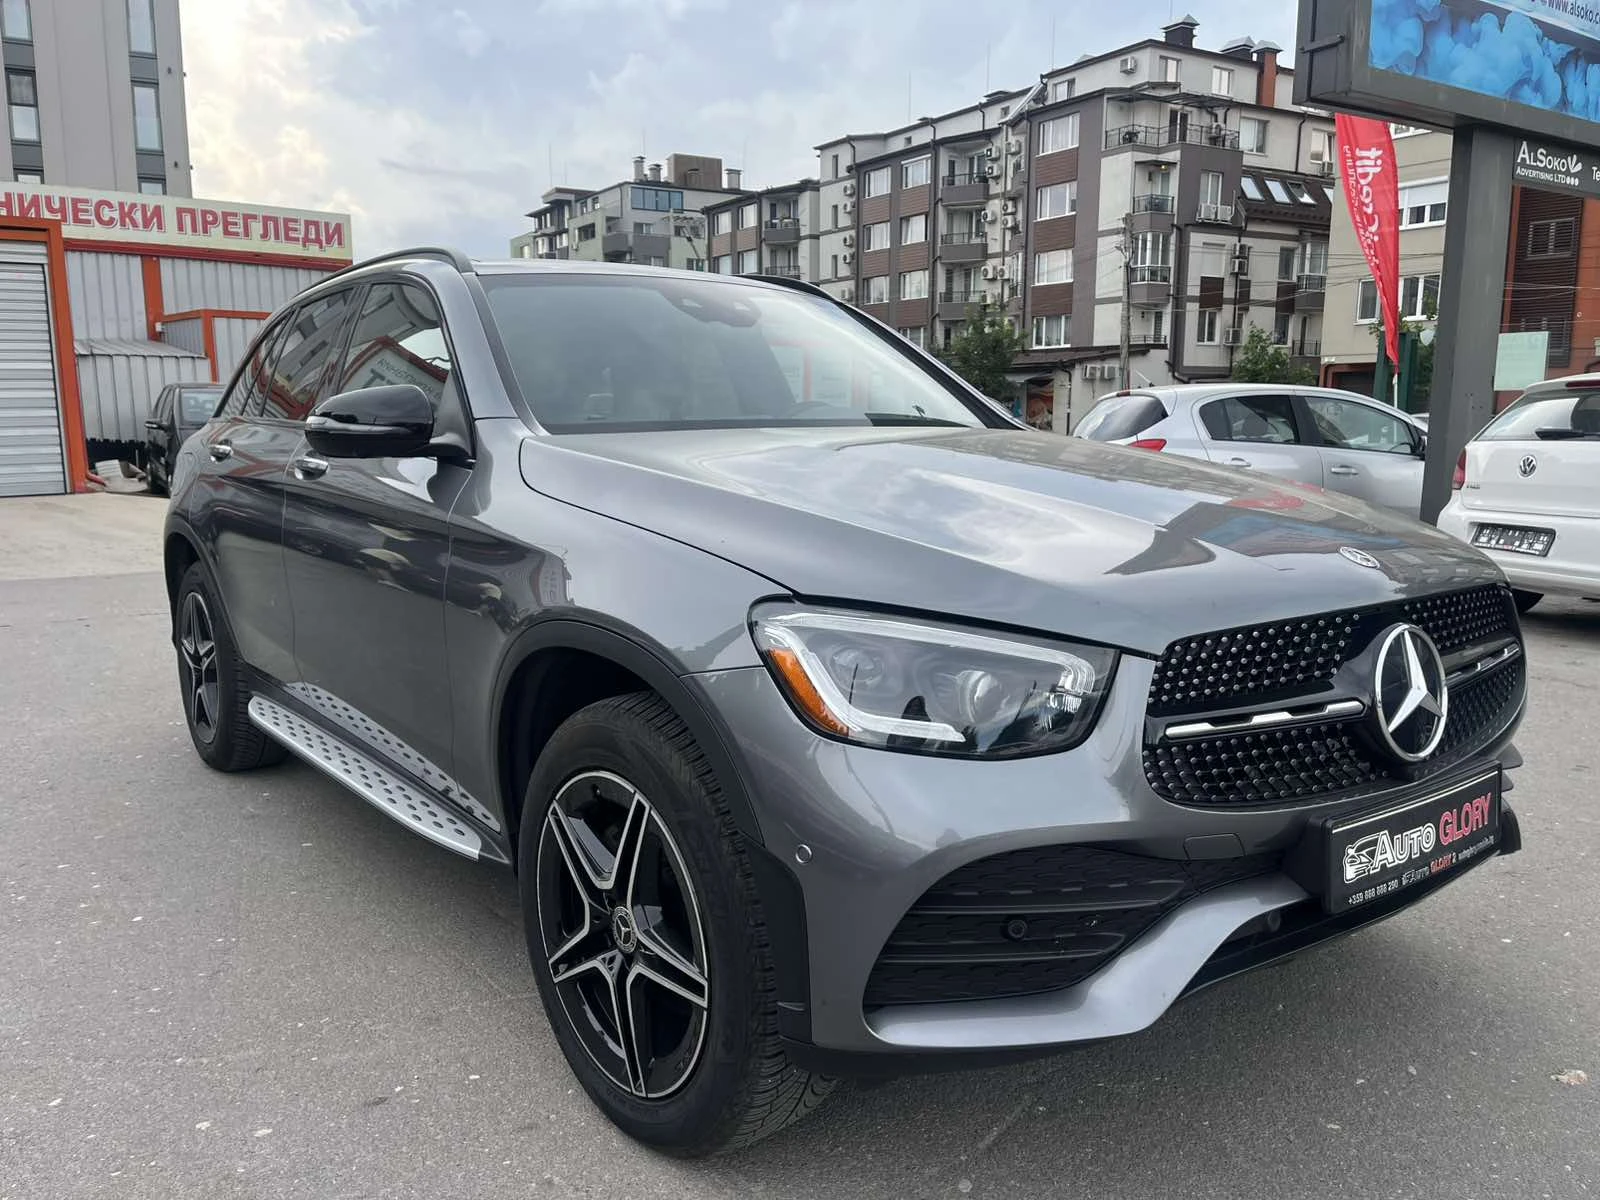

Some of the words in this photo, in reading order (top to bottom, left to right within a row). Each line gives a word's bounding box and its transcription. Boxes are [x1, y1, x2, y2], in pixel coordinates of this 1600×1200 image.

[1548, 0, 1600, 24] www.alsoko.c
[1516, 165, 1554, 182] ADVERTISING
[1554, 173, 1566, 184] LTD
[176, 206, 346, 249] ПРЕГЛЕДИ
[1370, 823, 1436, 874] AUTO
[1439, 792, 1492, 845] GLORY
[1430, 851, 1453, 873] GLORY
